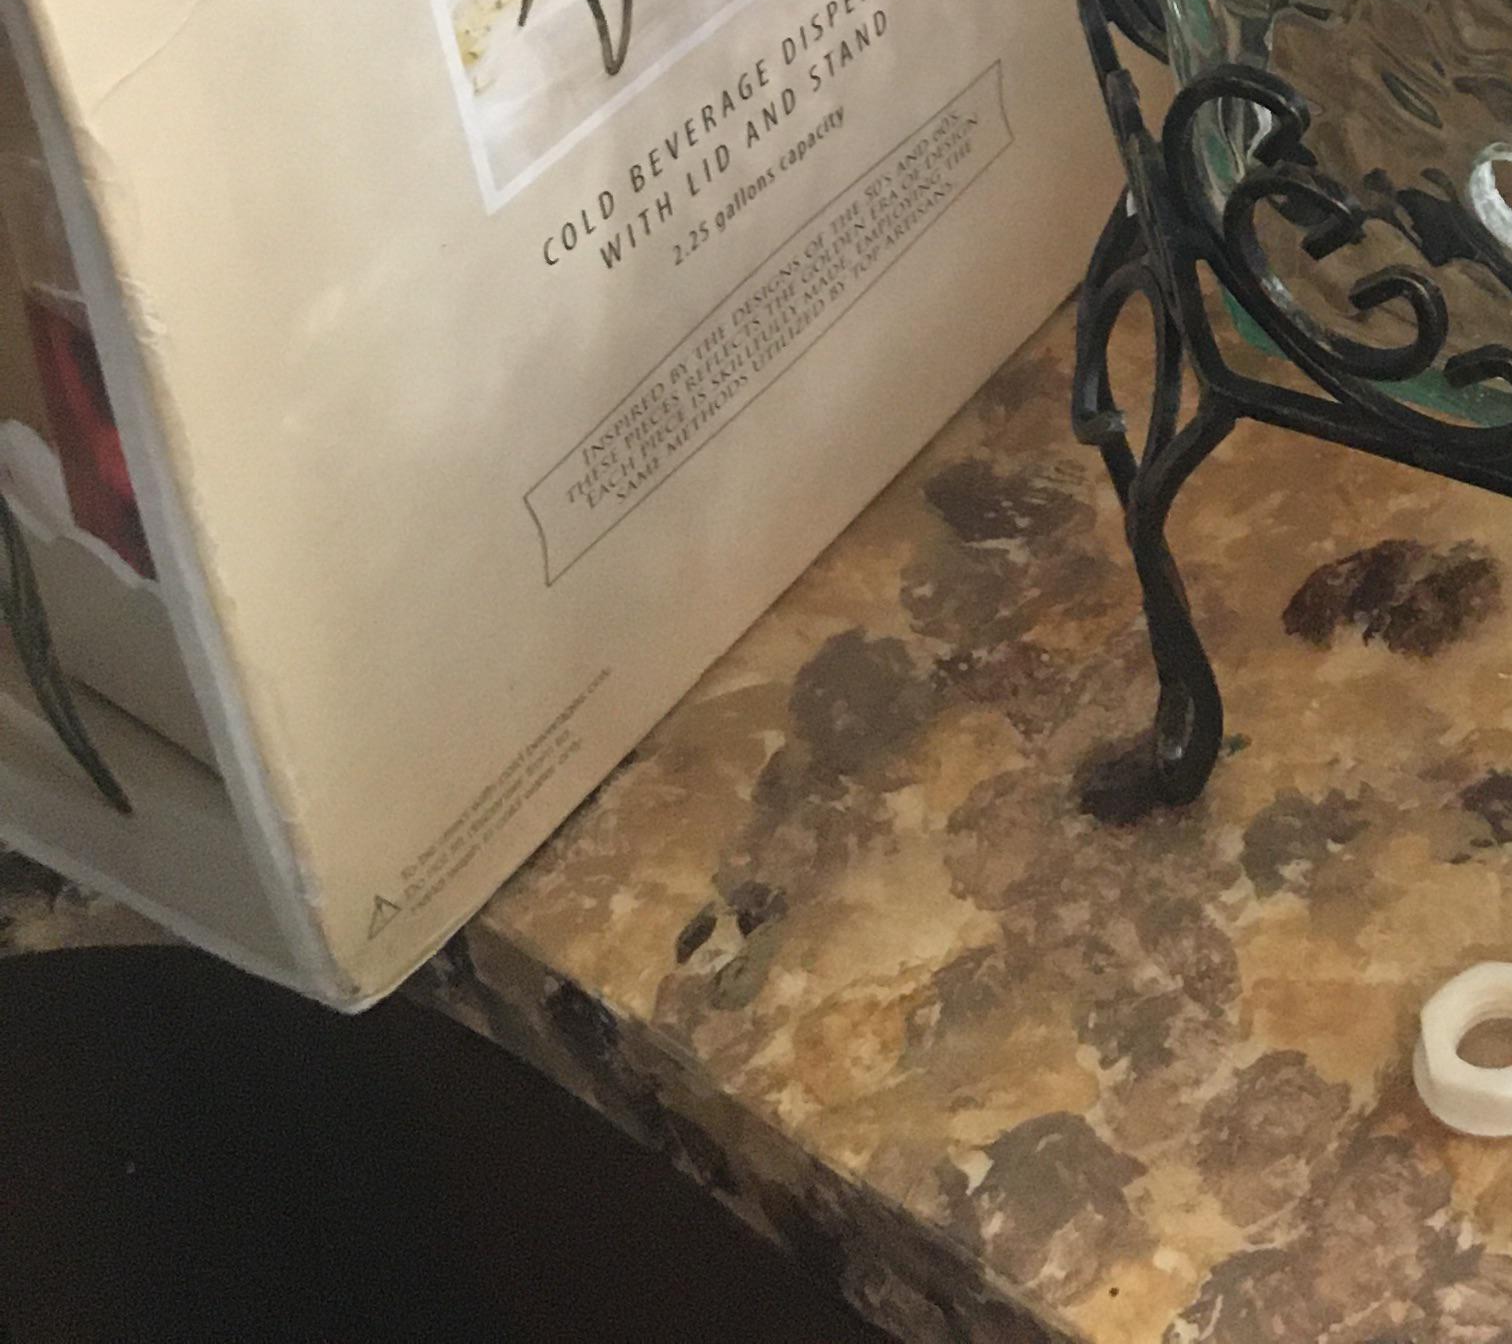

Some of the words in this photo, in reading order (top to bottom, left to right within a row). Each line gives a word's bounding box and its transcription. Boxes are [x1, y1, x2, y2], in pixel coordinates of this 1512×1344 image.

[542, 189, 616, 267] COLD
[629, 58, 770, 194] BEVERAGE
[600, 195, 675, 270] WITH
[686, 143, 731, 196] LID
[745, 87, 798, 149] AND
[808, 8, 890, 92] STAND
[672, 225, 711, 267] 2.25
[715, 168, 777, 234] gallons
[779, 105, 847, 172] capacity
[565, 447, 618, 505] THESE
[623, 389, 681, 451] PIECES
[581, 380, 666, 466] INSPIRED
[693, 326, 725, 363] THE
[730, 255, 802, 328] DESIGNS
[585, 454, 636, 510] EACH
